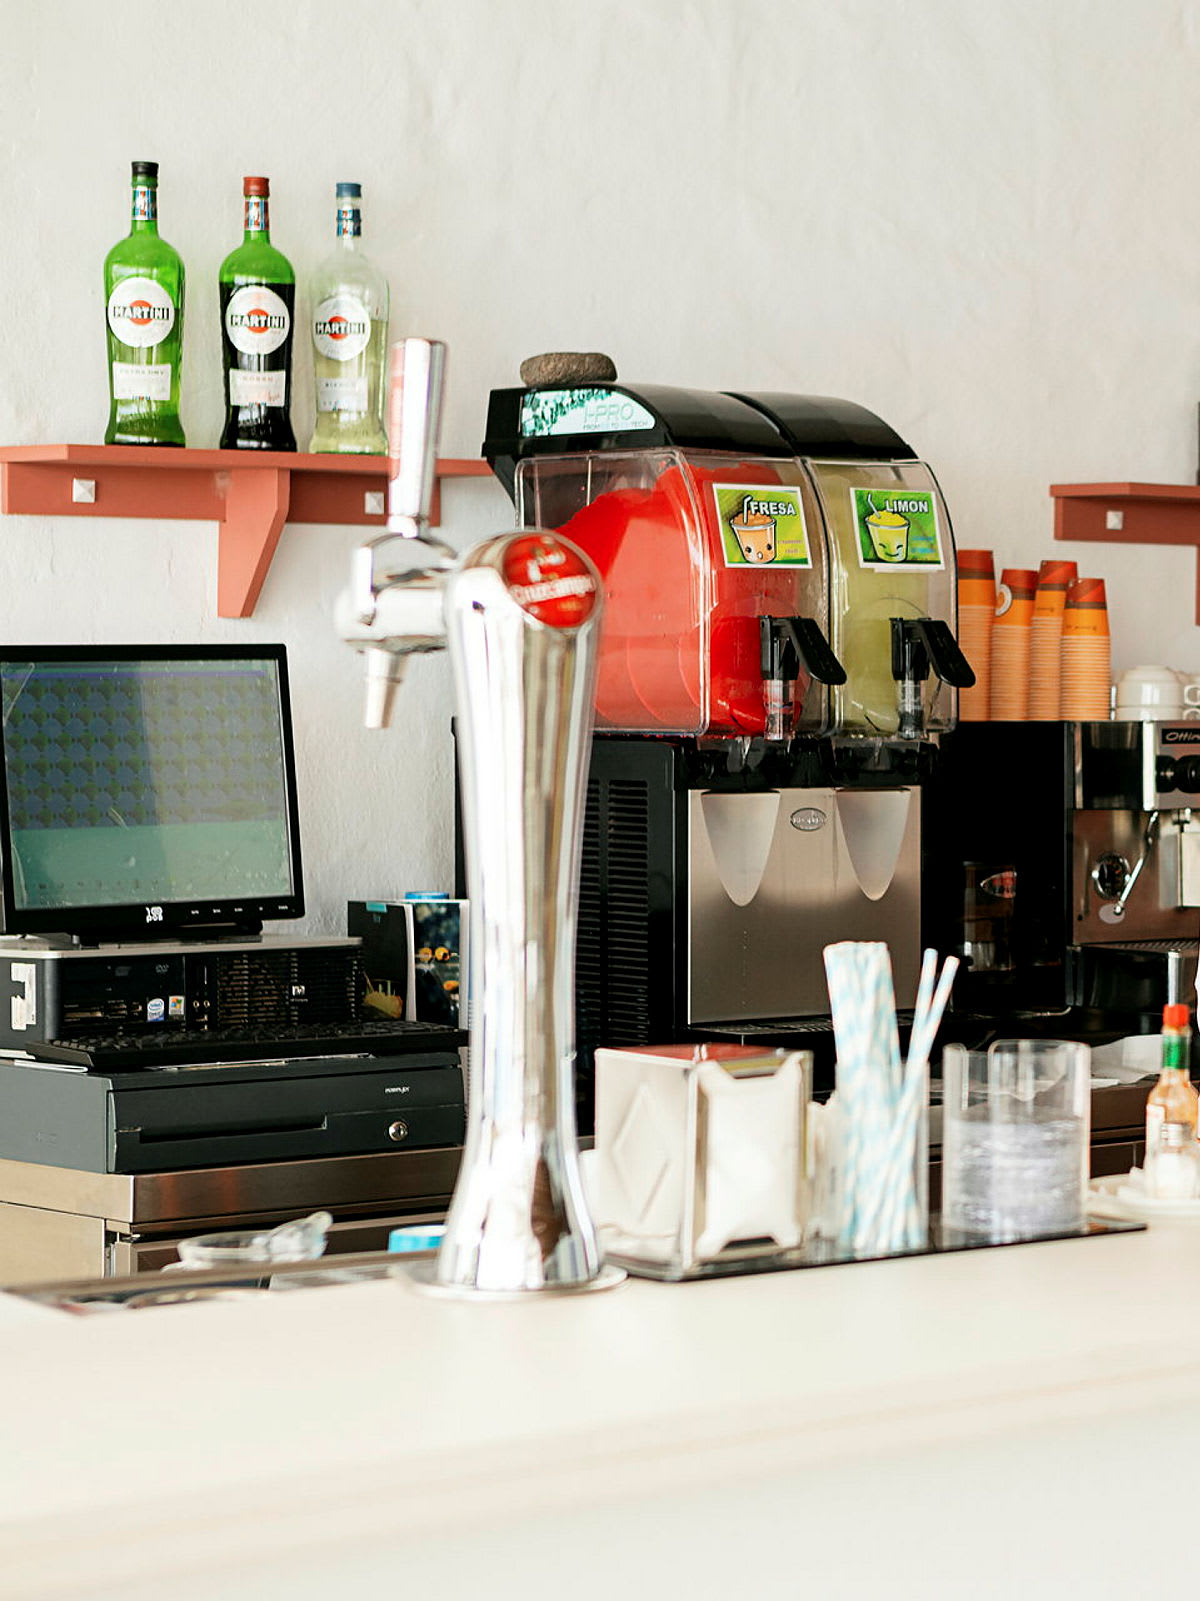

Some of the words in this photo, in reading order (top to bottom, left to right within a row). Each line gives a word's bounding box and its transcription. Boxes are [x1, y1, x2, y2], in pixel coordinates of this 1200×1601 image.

[113, 306, 170, 321] MARTINI
[230, 314, 285, 329] MARTINI
[315, 322, 365, 335] MARTINI
[750, 501, 796, 516] FRESA
[885, 499, 929, 513] LIMON
